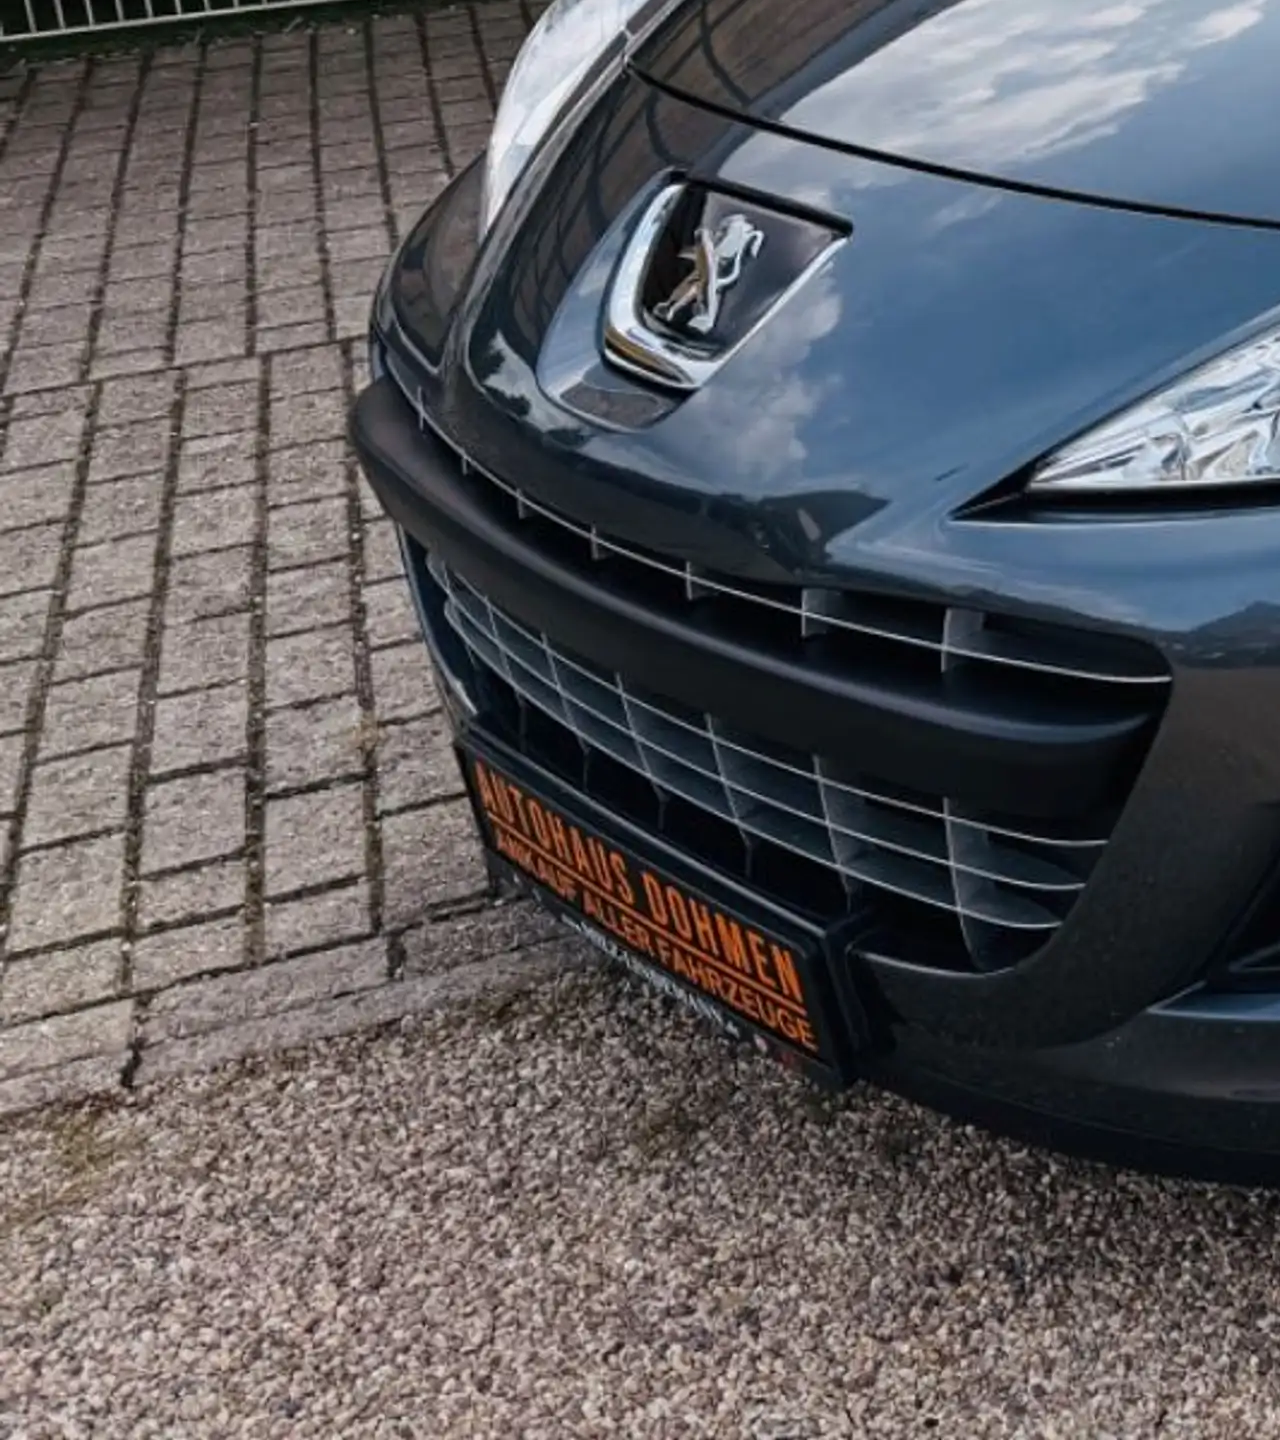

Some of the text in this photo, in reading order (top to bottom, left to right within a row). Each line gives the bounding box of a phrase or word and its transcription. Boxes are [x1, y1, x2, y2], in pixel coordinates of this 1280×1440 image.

[475, 760, 636, 906] AUTOHAUS
[641, 870, 806, 1003] DOHMEN
[583, 888, 651, 951] ALLER
[655, 936, 819, 1052] FAHRZEUGE
